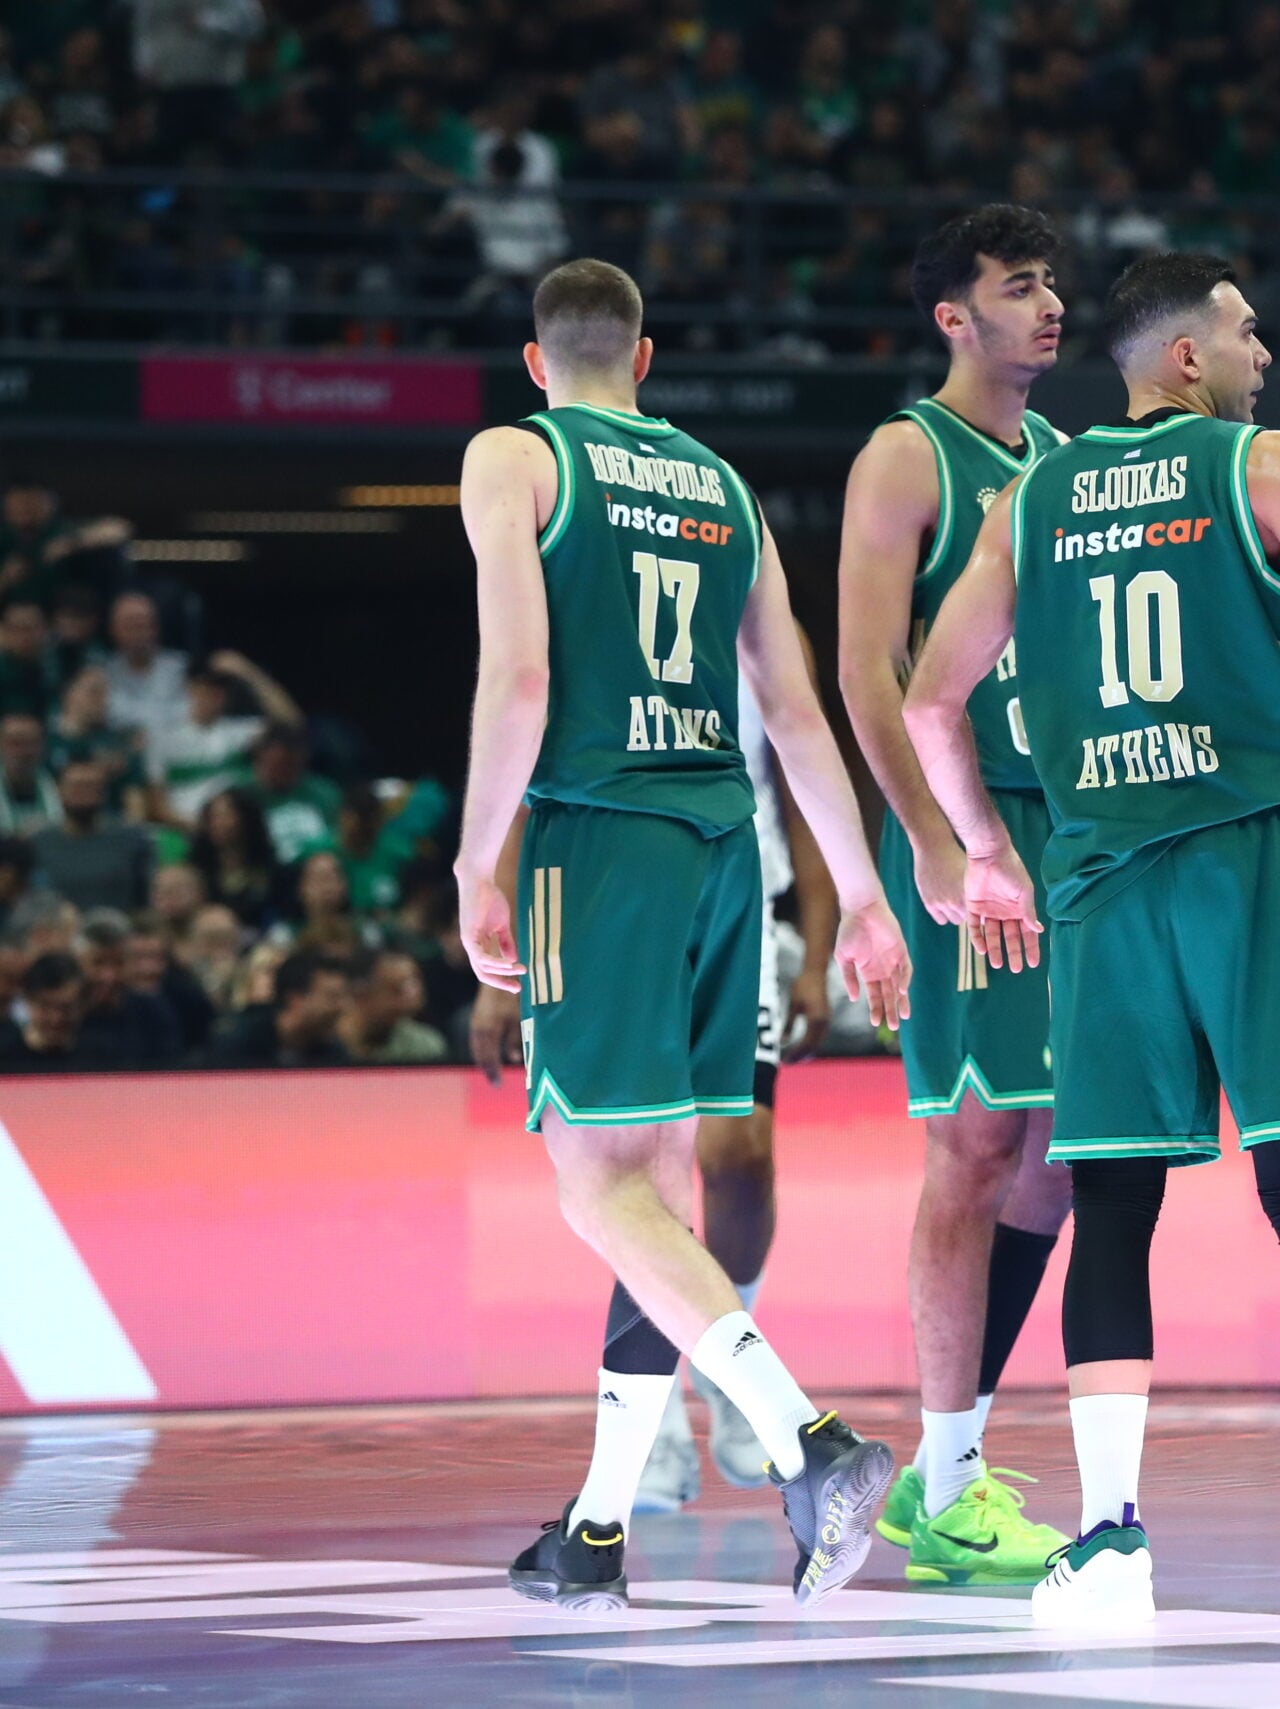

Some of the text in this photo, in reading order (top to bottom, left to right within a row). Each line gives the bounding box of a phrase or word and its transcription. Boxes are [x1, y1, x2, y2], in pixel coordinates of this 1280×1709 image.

[1072, 456, 1187, 514] SLOUKAS
[604, 493, 733, 546] instacar
[1055, 518, 1211, 563] instacar
[633, 551, 699, 684] 17
[1089, 570, 1184, 708] 10
[1075, 723, 1219, 790] ATHENS
[802, 1489, 849, 1593] THE CITY
